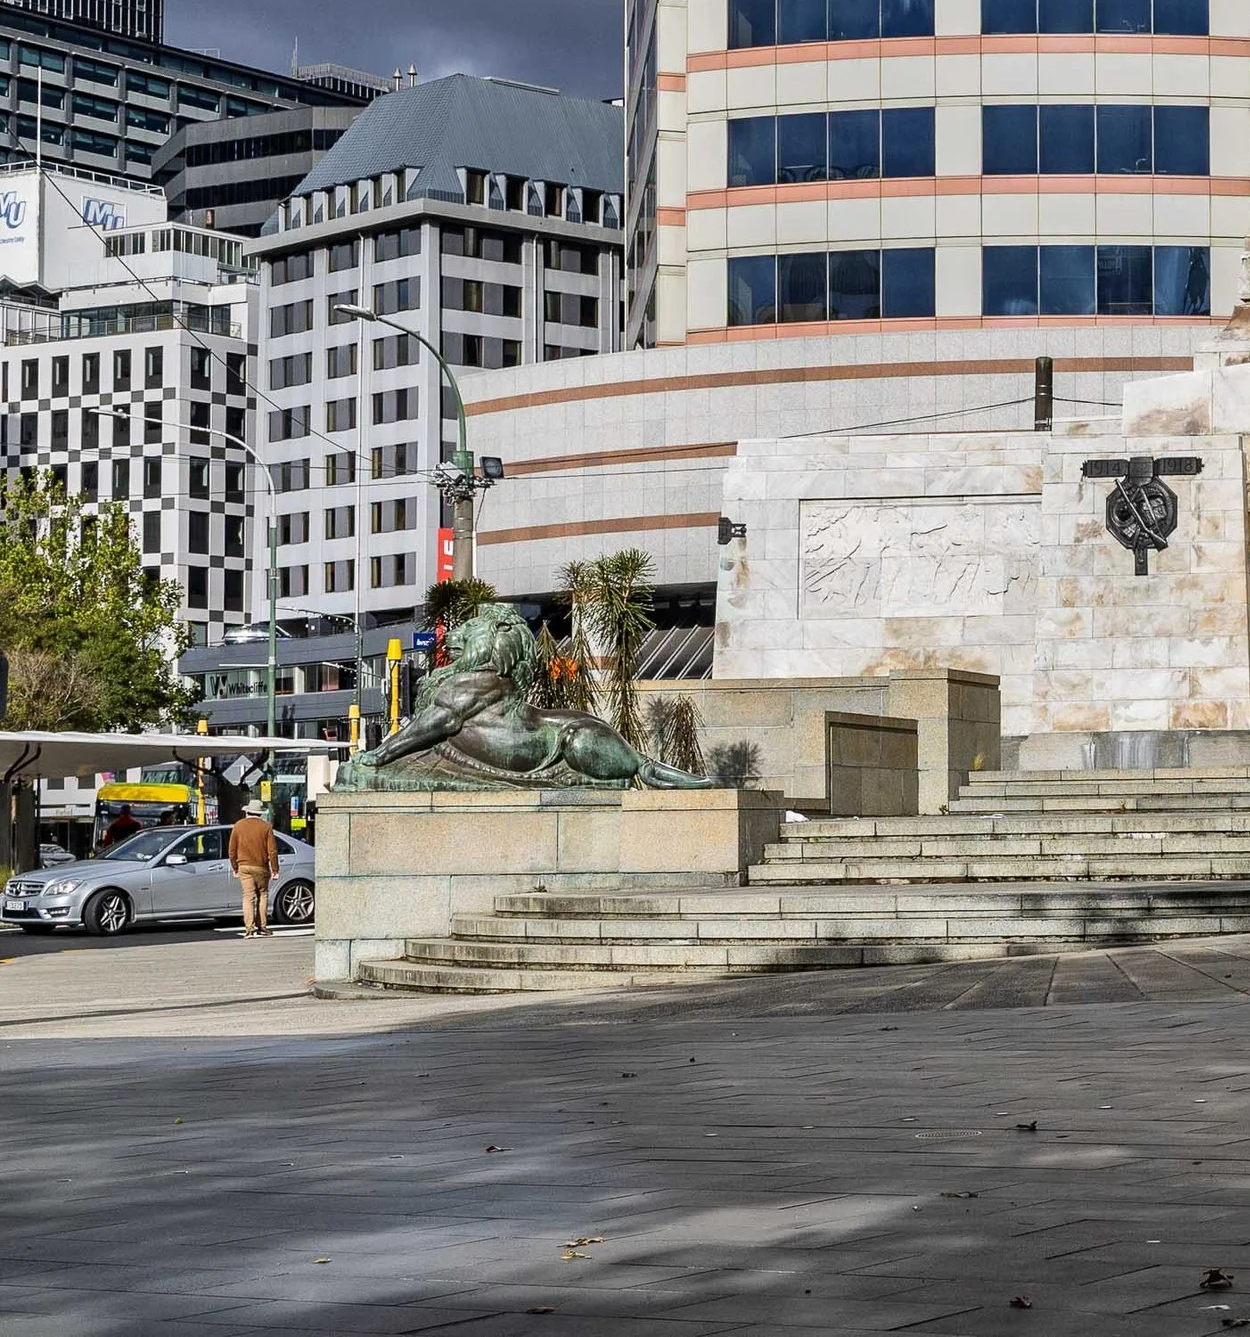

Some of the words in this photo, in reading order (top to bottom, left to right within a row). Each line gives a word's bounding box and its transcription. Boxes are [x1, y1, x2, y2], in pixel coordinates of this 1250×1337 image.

[1089, 461, 1121, 475] 1914
[1162, 458, 1194, 473] 1918
[228, 680, 268, 695] Whitecliffe
